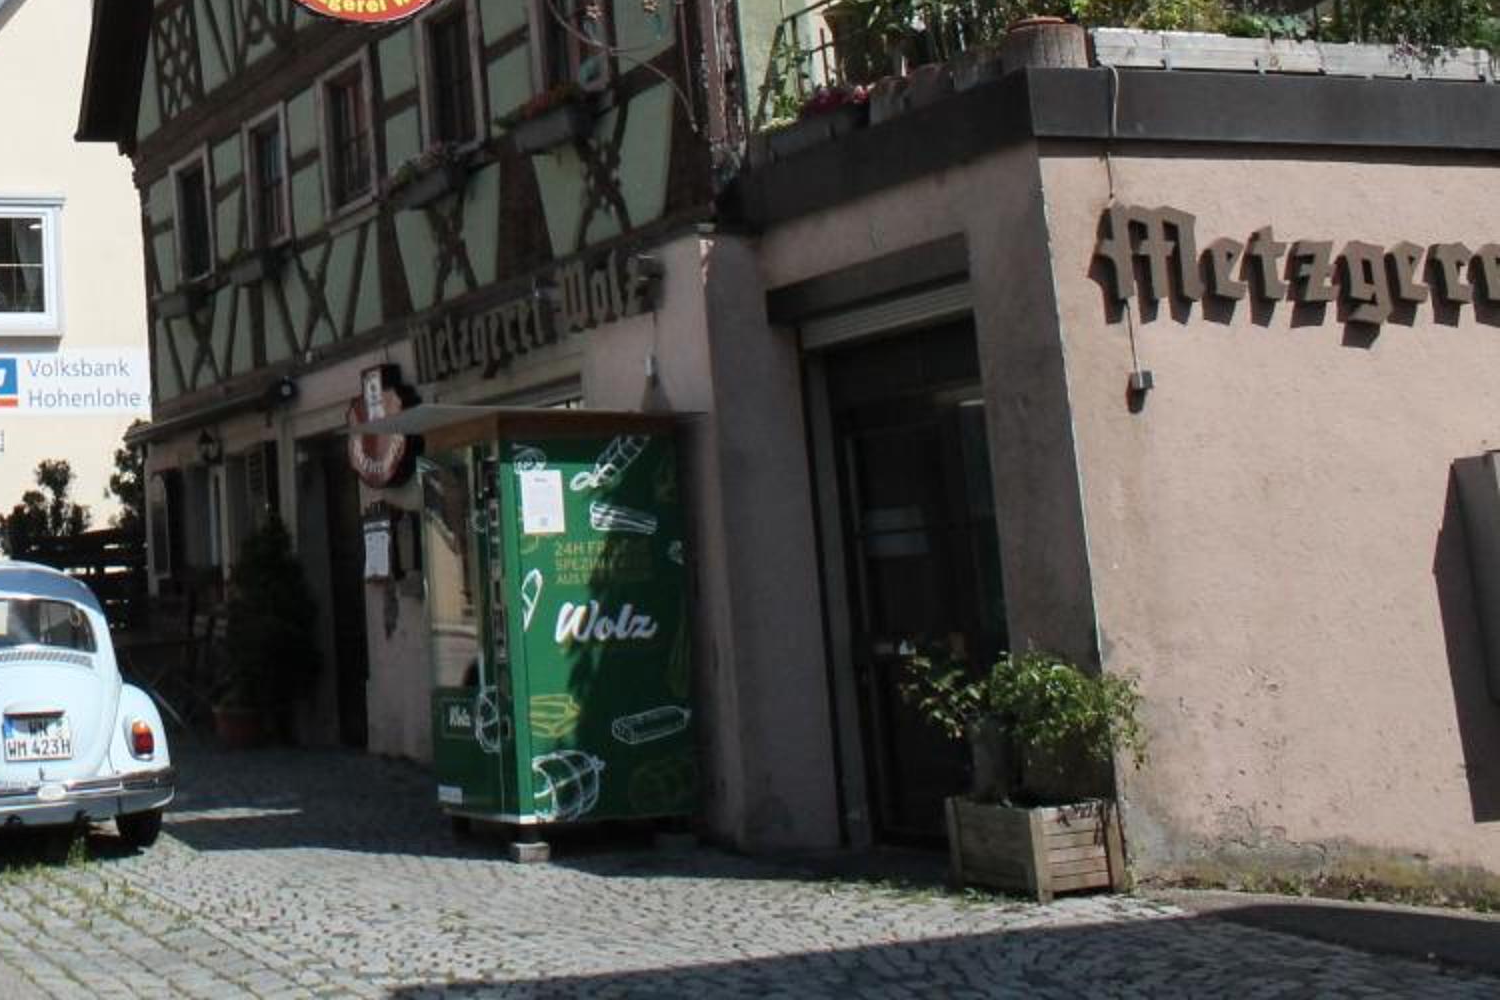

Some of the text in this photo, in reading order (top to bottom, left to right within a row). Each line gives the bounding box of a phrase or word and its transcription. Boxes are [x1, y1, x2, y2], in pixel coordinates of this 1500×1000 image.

[407, 296, 547, 383] Metzgerei
[27, 358, 131, 378] Volksbank
[28, 387, 142, 408] Hohenlohe
[555, 600, 657, 644] Wolz
